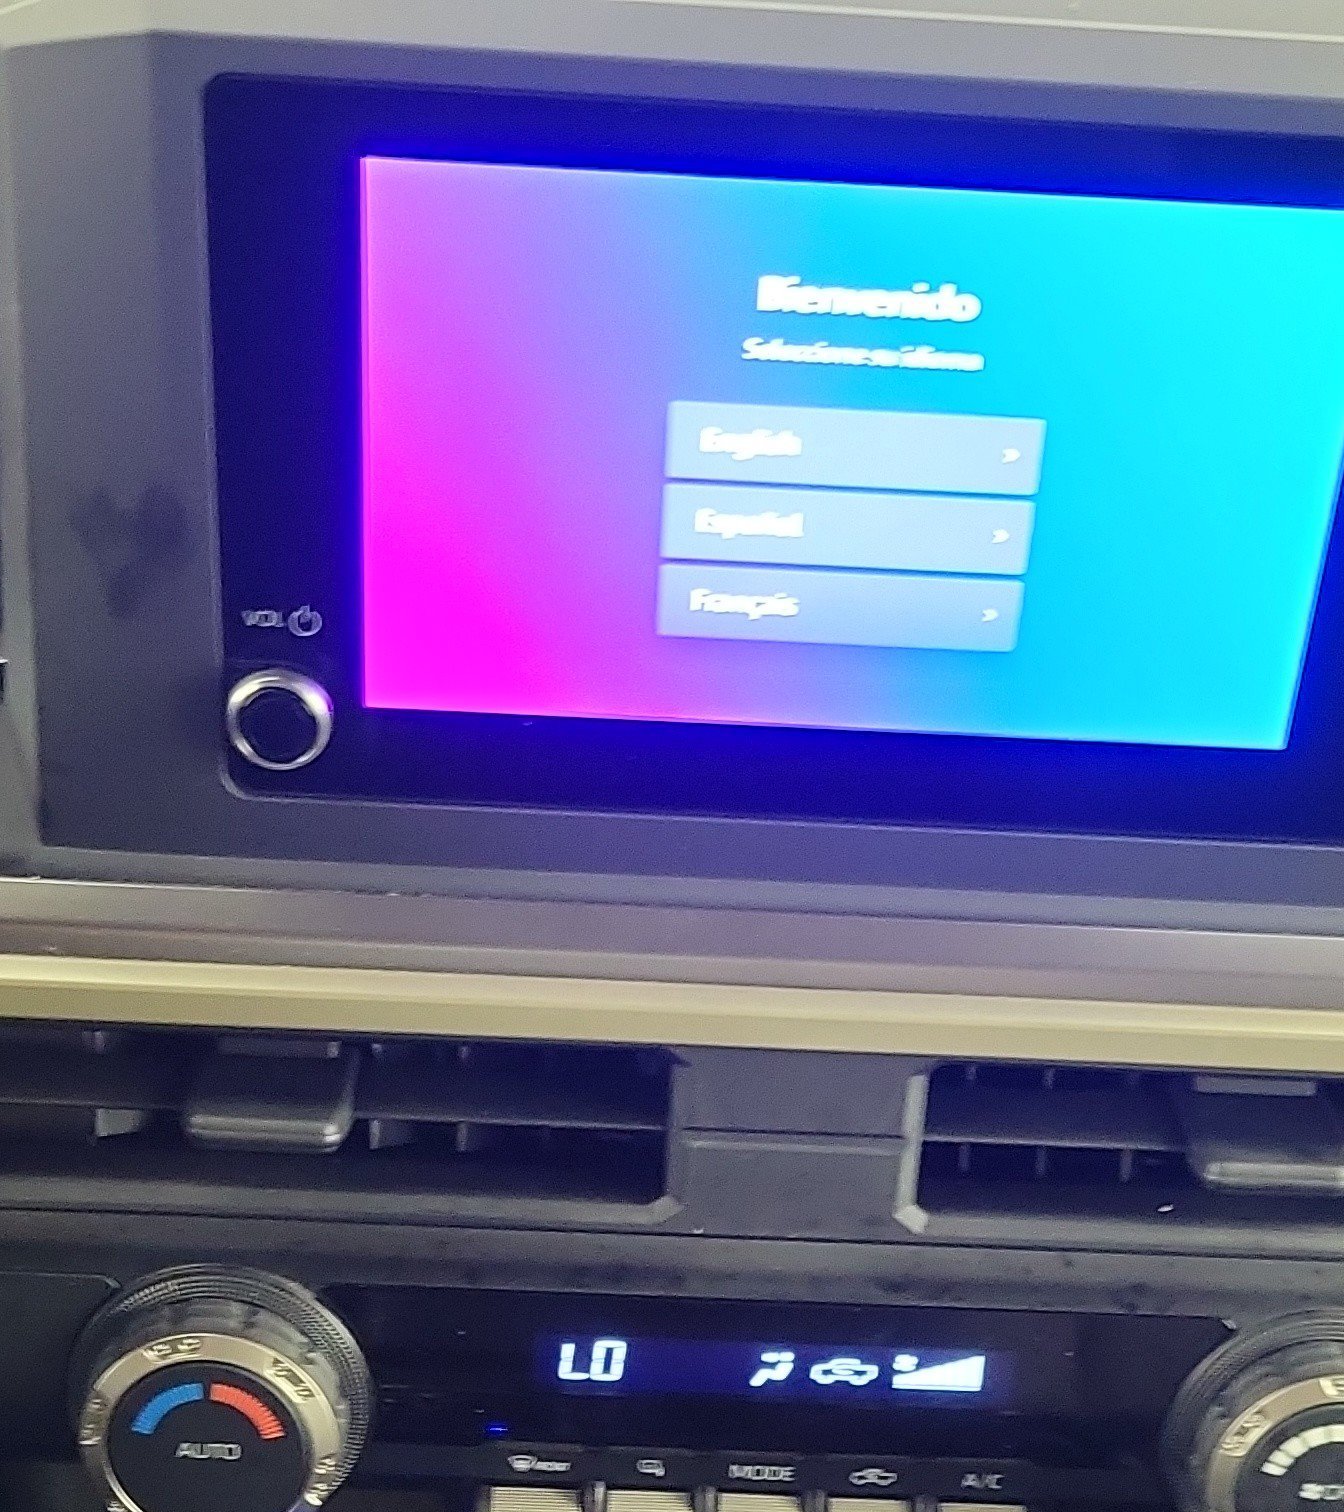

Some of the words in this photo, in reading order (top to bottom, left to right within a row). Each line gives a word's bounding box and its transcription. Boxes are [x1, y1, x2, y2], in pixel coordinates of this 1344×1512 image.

[756, 274, 983, 324] Bienvenido
[699, 426, 803, 462] English
[693, 506, 805, 540] Español
[240, 609, 285, 628] VOL
[689, 587, 801, 621] Français
[557, 1339, 628, 1382] LO
[174, 1441, 243, 1461] AUTO
[727, 1463, 797, 1483] MODE
[960, 1471, 1006, 1491] A/C
